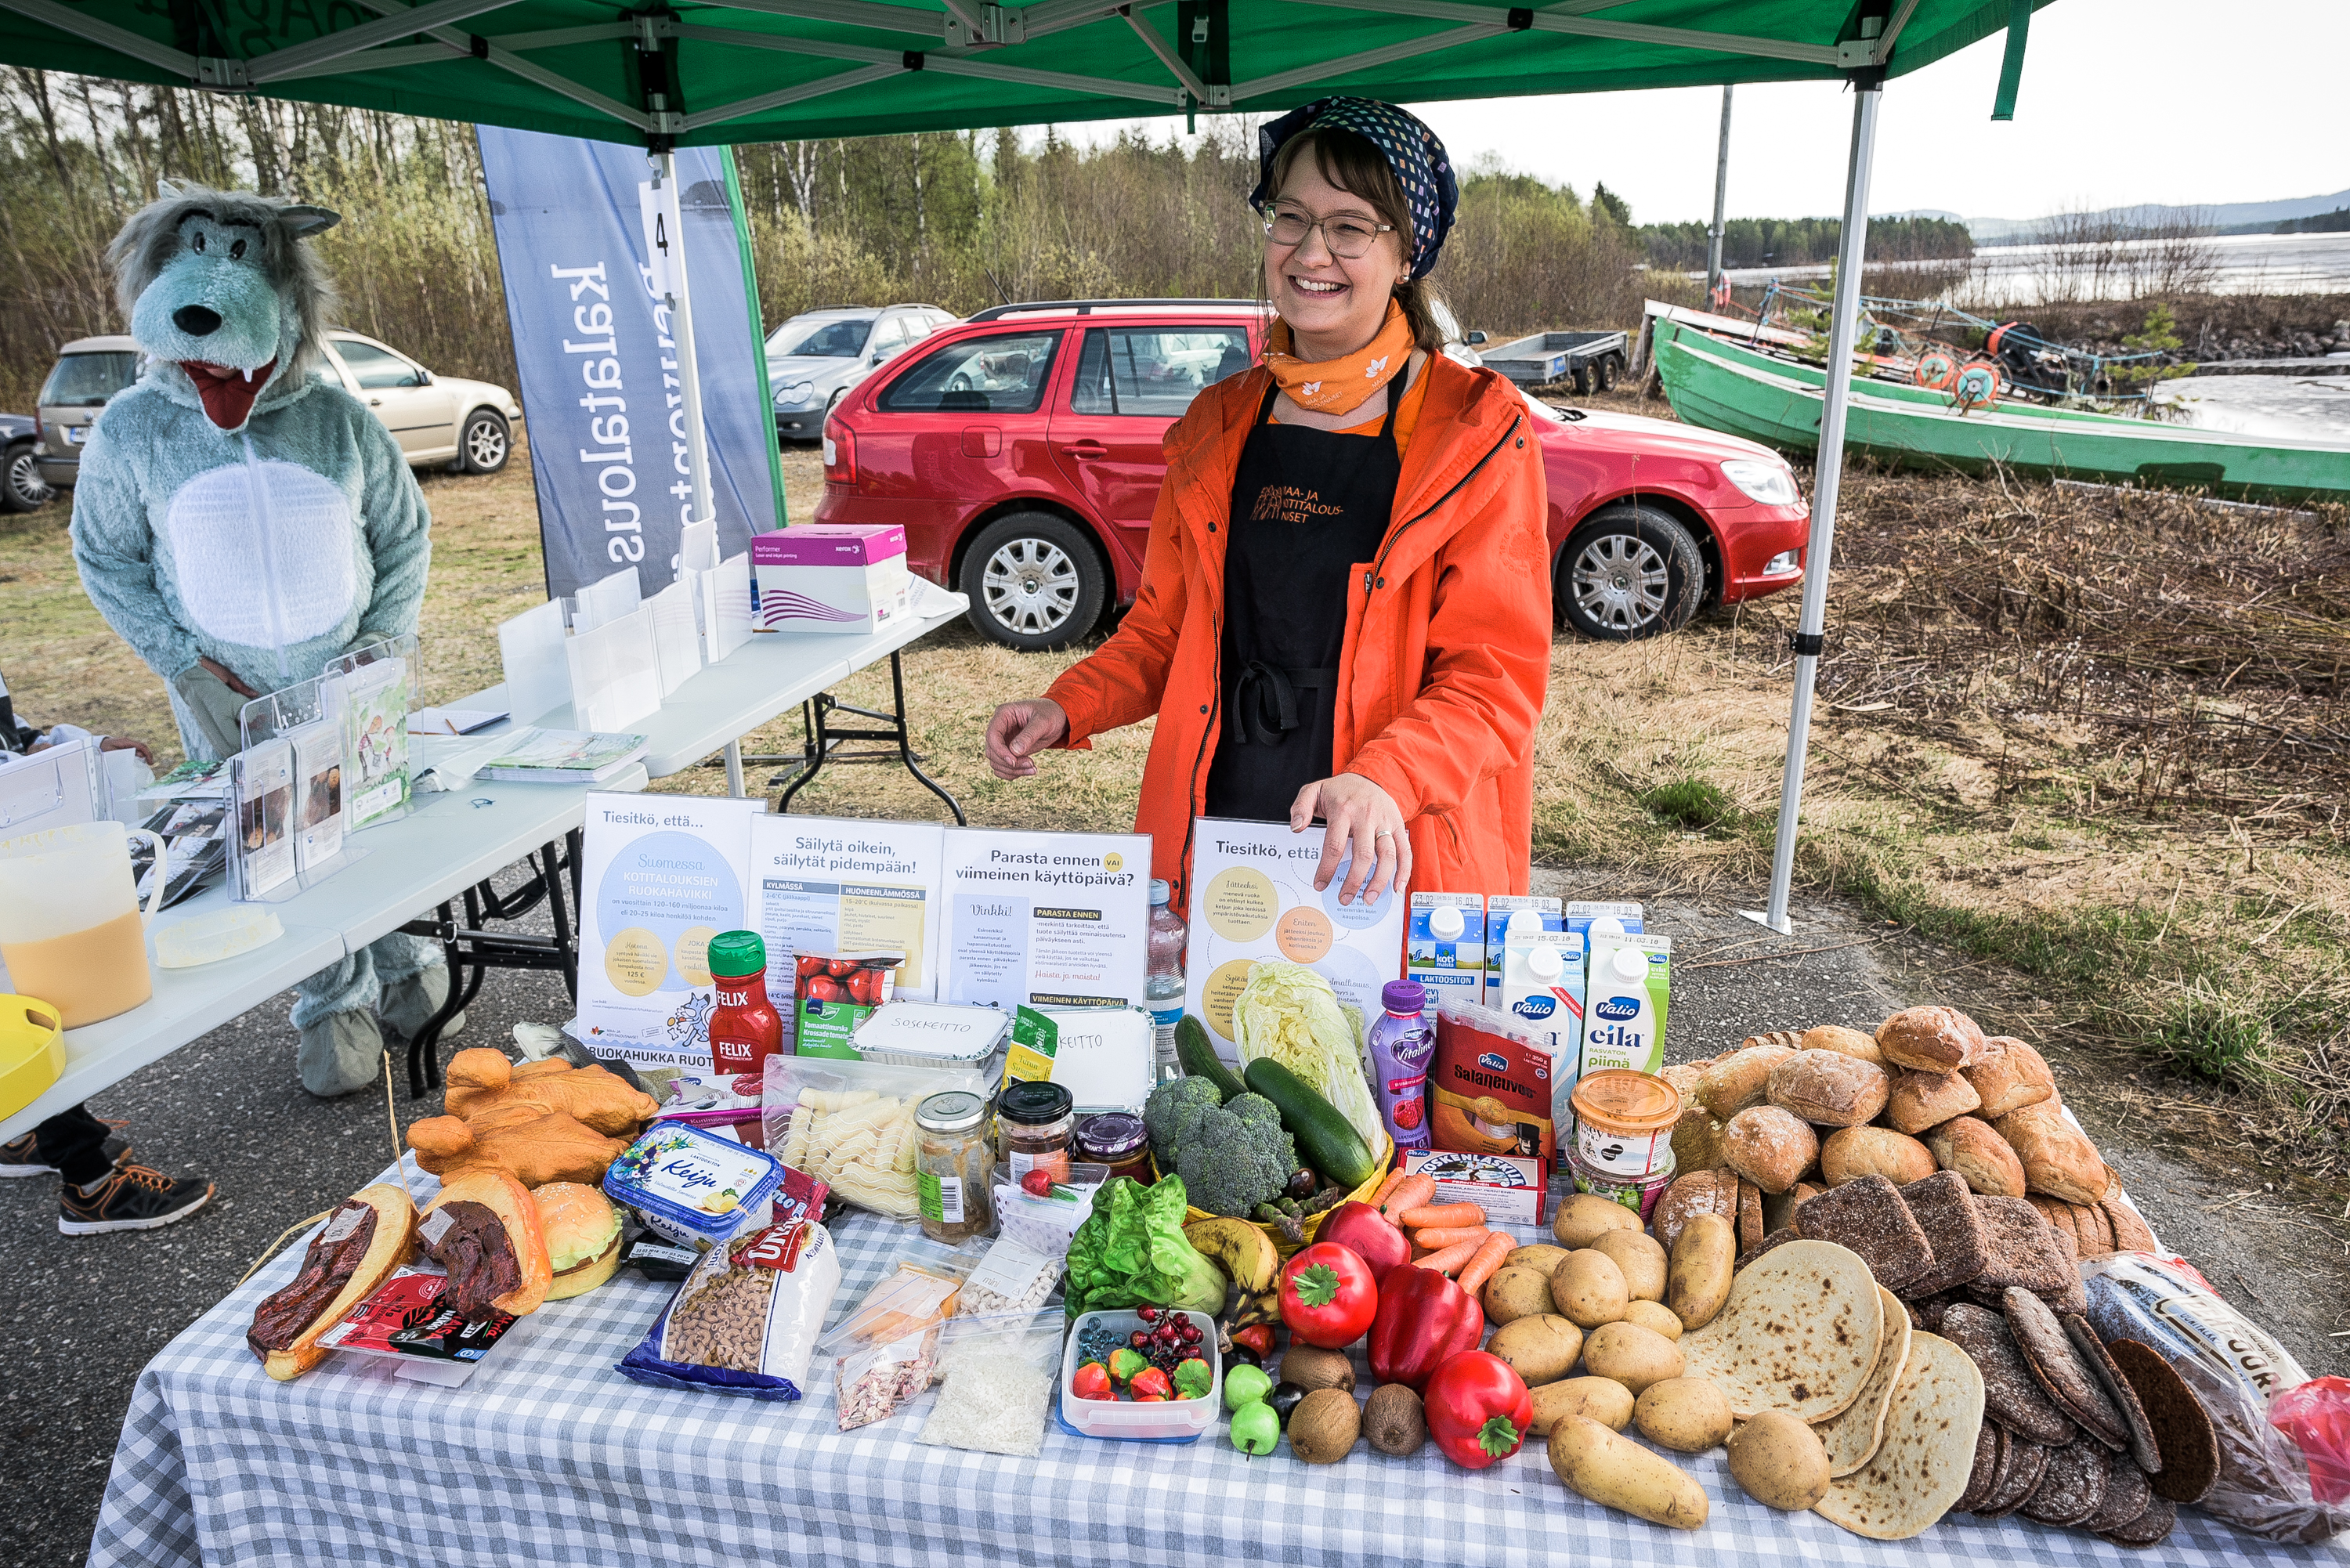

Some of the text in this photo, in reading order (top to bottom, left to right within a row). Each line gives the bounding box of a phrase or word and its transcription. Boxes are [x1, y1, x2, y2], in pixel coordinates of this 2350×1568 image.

[656, 212, 668, 257] 4
[1372, 376, 1384, 388] MAA-
[1305, 397, 1318, 406] MAA-
[1307, 392, 1343, 410] LOUSNAISET
[1305, 490, 1318, 501] JA
[1283, 498, 1343, 515] OTITALOUS-
[603, 811, 659, 827] Tiesitkö,
[796, 836, 896, 857] Säilytä oikein,
[1216, 840, 1319, 860] Tiesitkö, että
[638, 853, 705, 871] Suomessa
[774, 853, 916, 874] säilytät pidempään!
[991, 850, 1048, 865] Parasta
[1053, 856, 1100, 866] ennen
[624, 872, 718, 887] KOTITALOUKSIEN
[956, 866, 1134, 887] viimeinen käyttöpäivä?
[766, 881, 803, 891] KYLMÄSSÄ
[1226, 880, 1258, 889] Jätteeksi
[628, 885, 712, 900] RUOKAHÄVIKKI
[846, 887, 920, 899] HUONEENLÄMMÖSSÄ
[1415, 894, 1473, 905] 23.02 16.03
[970, 904, 1012, 916] Vinkki!
[1491, 898, 1549, 908] 23.02 16.03
[1572, 905, 1632, 915] 23.02 16.03
[1293, 918, 1317, 927] Eniten
[1437, 954, 1455, 963] koti
[1035, 970, 1061, 978] Haista
[1061, 972, 1070, 982] ja
[1420, 975, 1471, 984] LAKTOOSITON
[717, 990, 748, 1006] FELIX
[1073, 996, 1124, 1006] KÄYTTÖPÄIVÄ
[1556, 988, 1581, 1014] ENTISTÄ PAREMPI
[1516, 1003, 1552, 1014] Valio
[1598, 1004, 1636, 1015] Valio
[804, 1021, 848, 1031] Tomaattimurska
[891, 1018, 971, 1032] SOSEKEITTO
[1059, 1035, 1102, 1050] KEITTO
[1590, 1024, 1641, 1047] eila
[589, 1046, 675, 1064] RUOKAHUKKA
[679, 1055, 713, 1068] RUOT
[719, 1042, 752, 1057] FELIX
[1019, 1054, 1039, 1070] Turun
[1481, 1057, 1504, 1070] Valio
[1589, 1056, 1629, 1068] piimä
[1011, 1063, 1039, 1081] Sinappia
[1454, 1064, 1534, 1099] Salaneuvos
[690, 1114, 761, 1124] Kuningatarpiirakka
[690, 1153, 721, 1167] LAKTOOSITON
[661, 1159, 717, 1189] Keiju
[1418, 1154, 1524, 1187] KOSKENLASKIJA
[650, 1216, 689, 1238] Keiju
[662, 1251, 689, 1259] 07.03.2018
[707, 1243, 726, 1267] roni
[982, 1274, 1001, 1288] mini
[430, 1310, 456, 1330] NAKKI
[435, 1316, 463, 1339] AISA
[869, 1352, 888, 1367] mini
